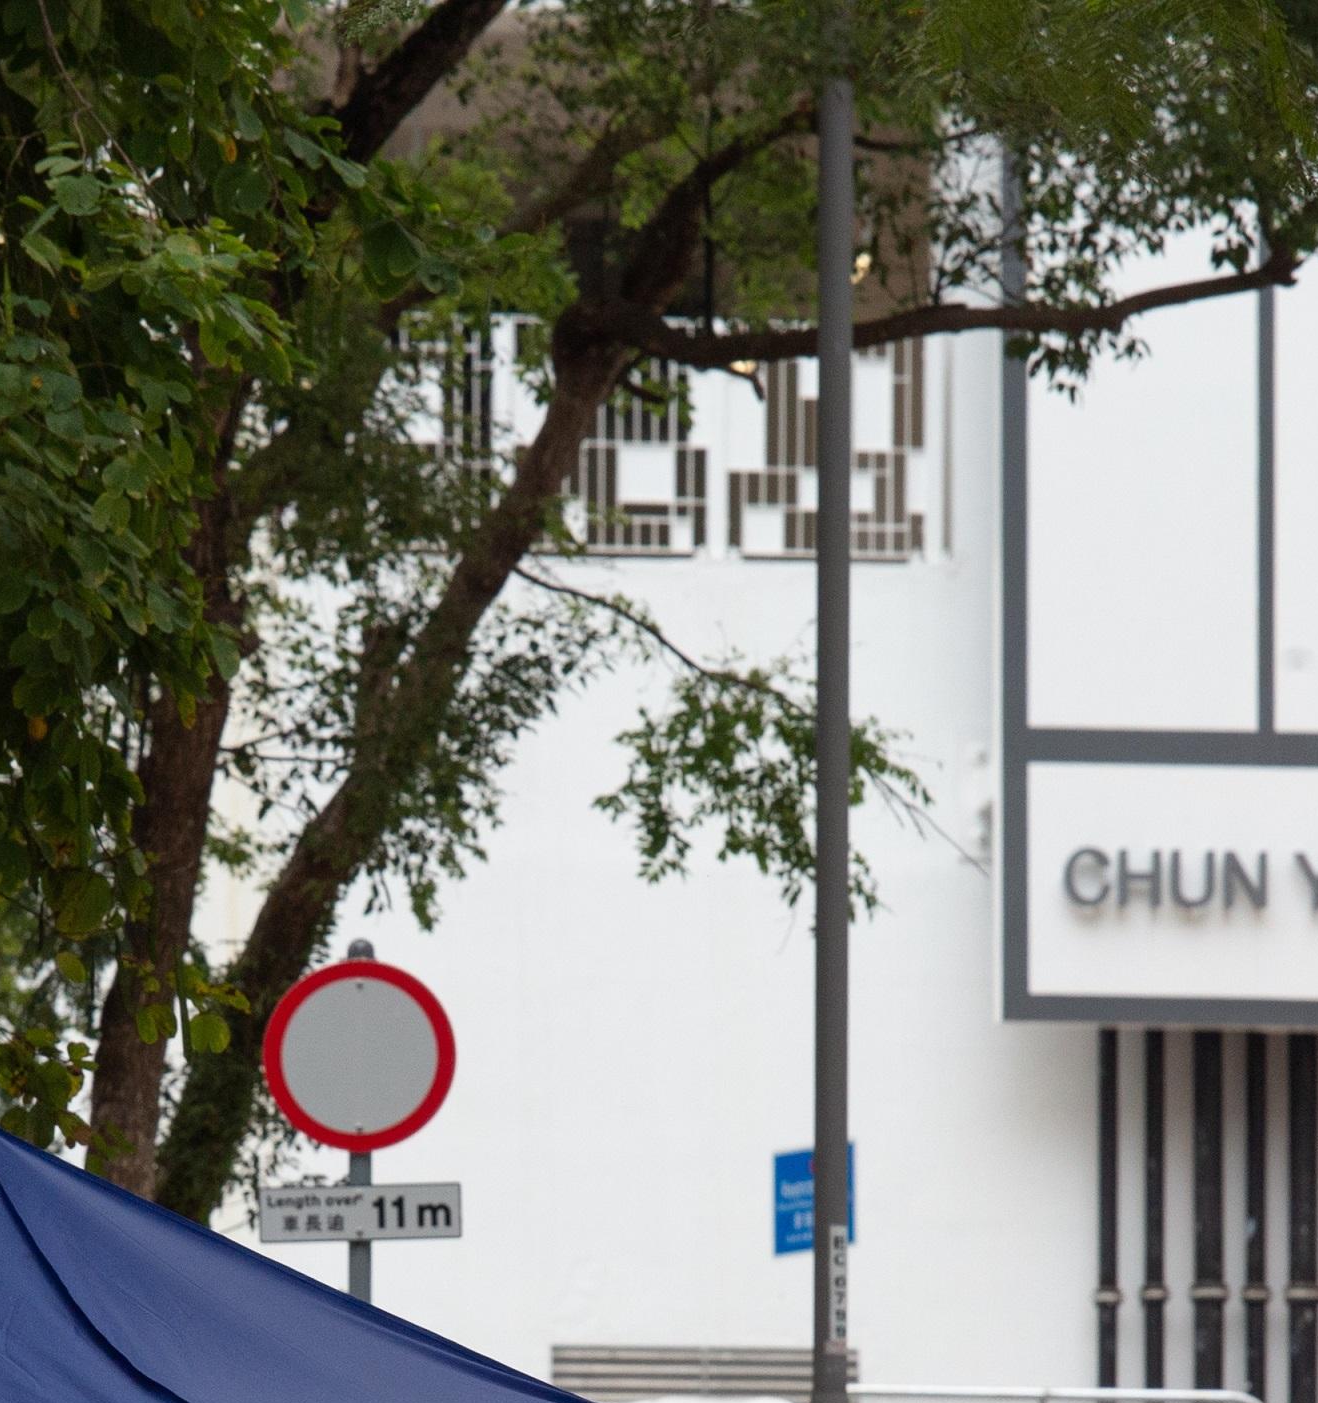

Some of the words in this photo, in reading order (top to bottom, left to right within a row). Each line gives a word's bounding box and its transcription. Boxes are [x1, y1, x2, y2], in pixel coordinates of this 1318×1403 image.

[1063, 846, 1269, 911] CHUN
[266, 1194, 322, 1210] Length
[371, 1195, 406, 1229] 11
[417, 1202, 452, 1228] m
